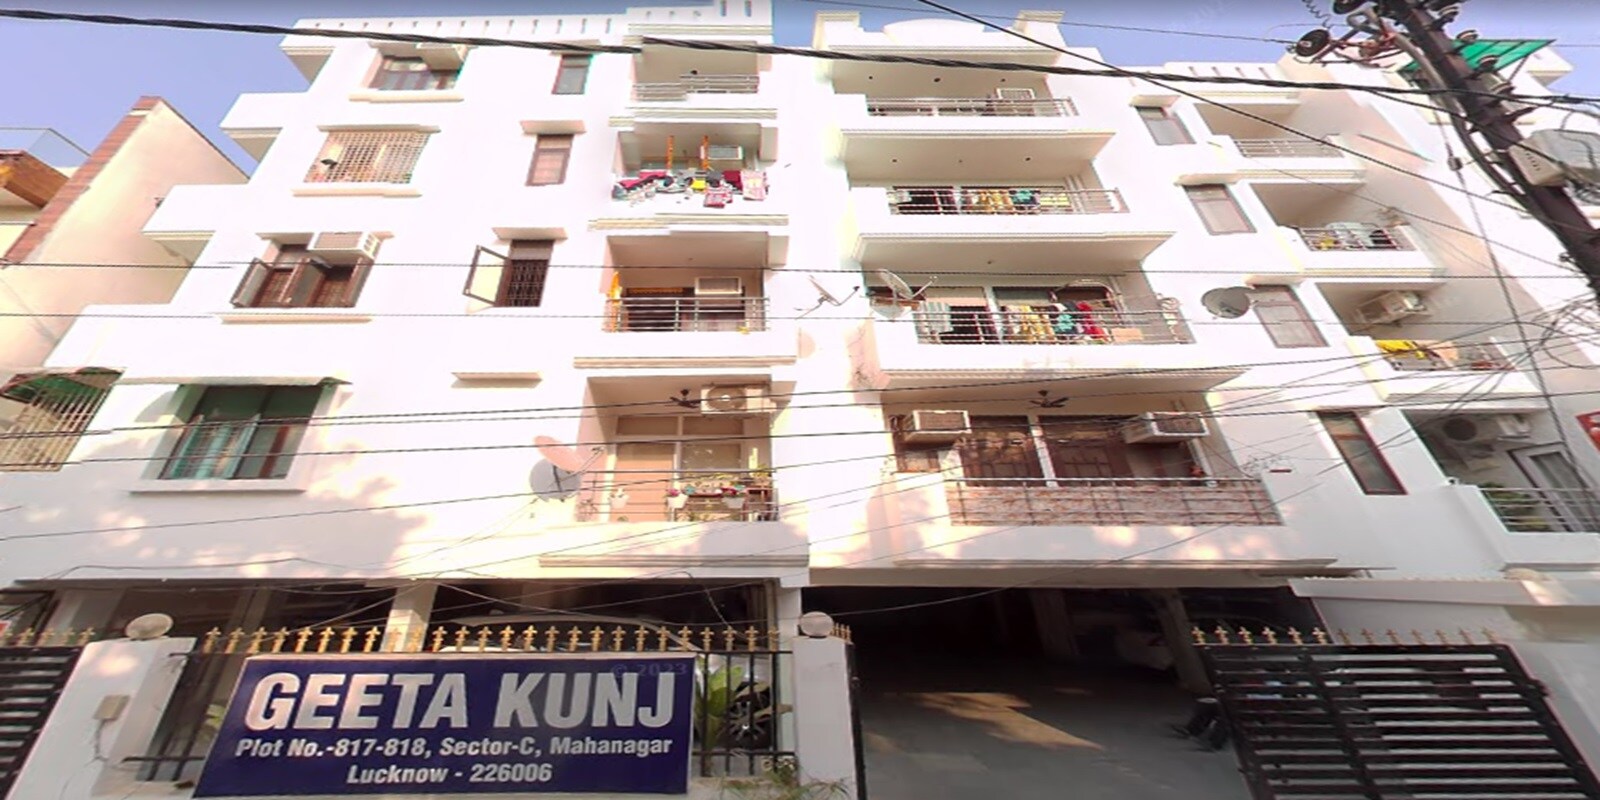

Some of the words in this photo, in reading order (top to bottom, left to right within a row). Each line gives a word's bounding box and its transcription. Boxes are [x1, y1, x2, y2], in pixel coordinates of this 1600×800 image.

[244, 672, 468, 731] GEETA
[493, 672, 675, 728] KUNJ
[235, 738, 283, 757] Plot
[287, 738, 431, 759] No.-817-818,
[439, 737, 542, 758] Sector-C,
[550, 736, 673, 758] Mahanagar
[346, 764, 449, 784] Lucknow
[469, 763, 553, 783] 226006
